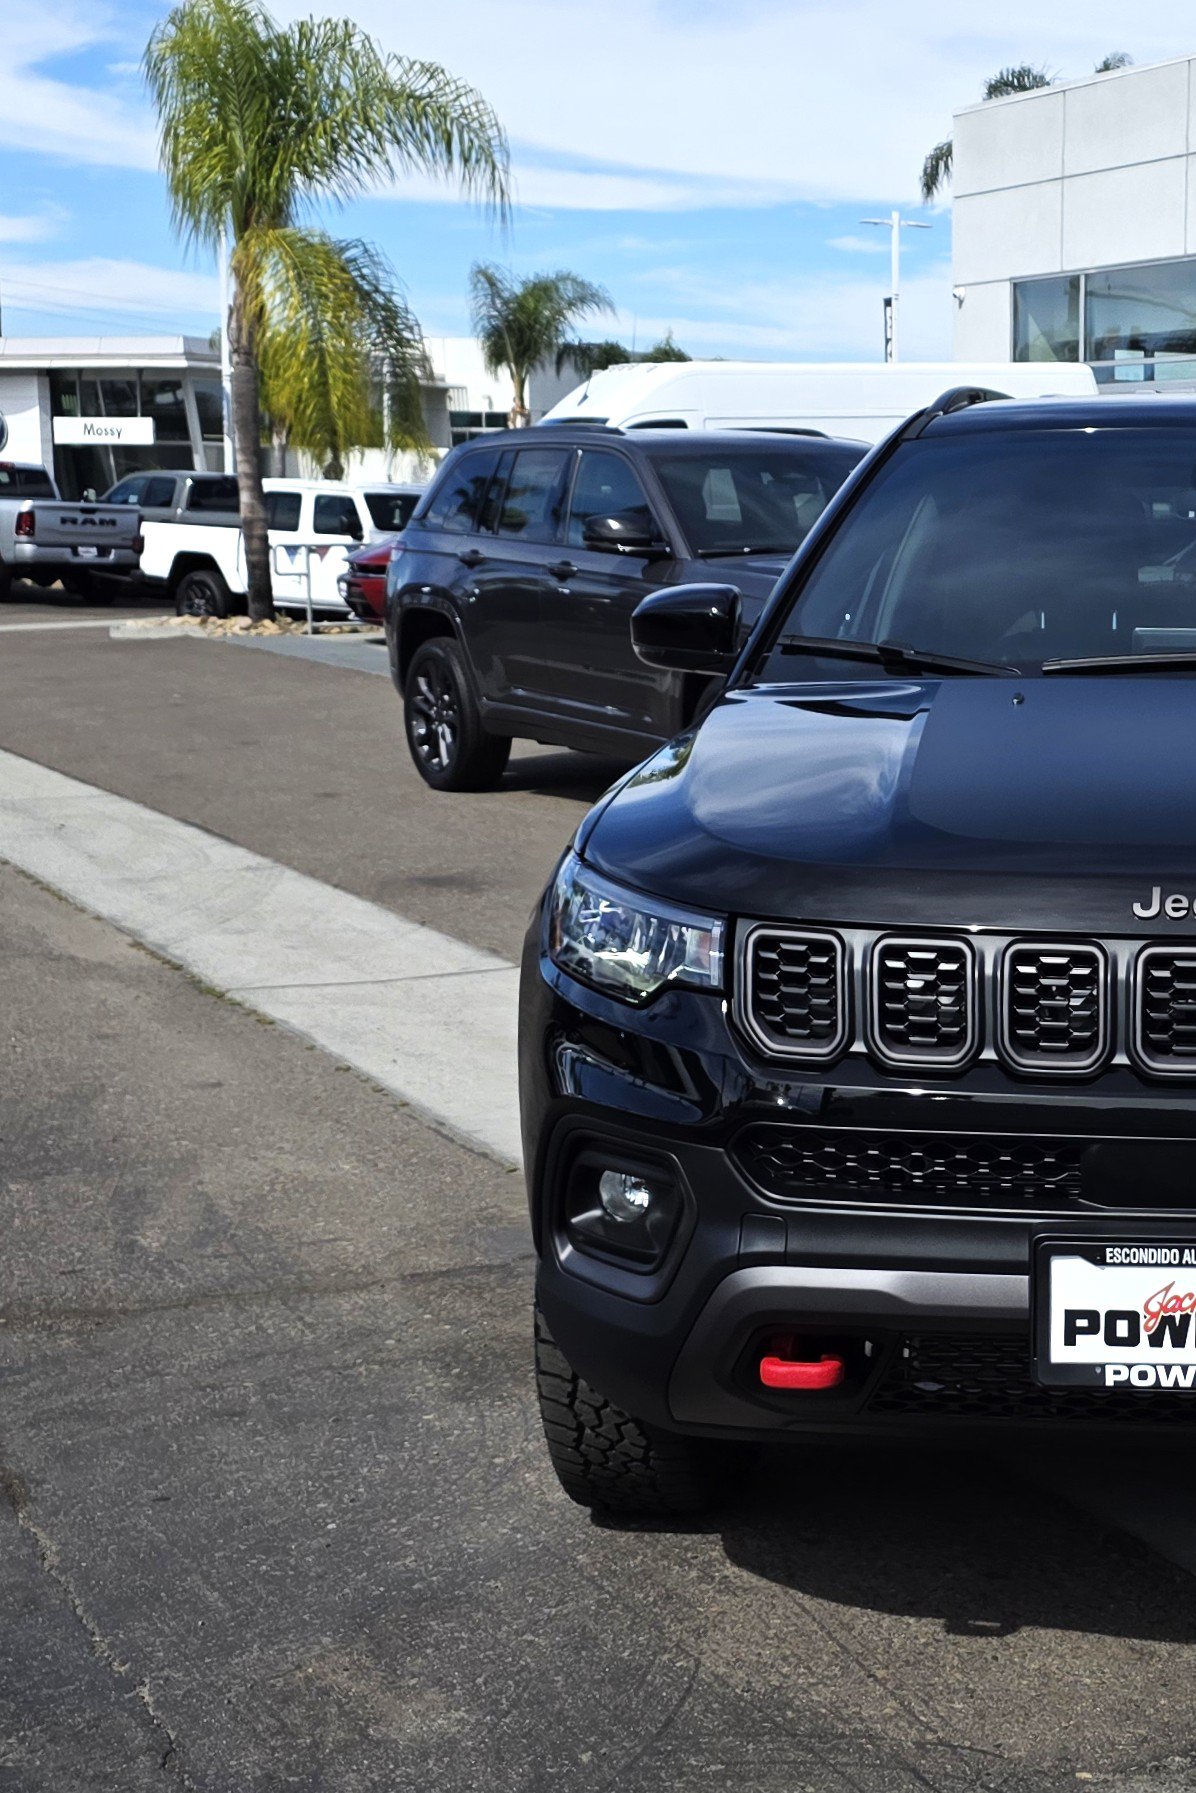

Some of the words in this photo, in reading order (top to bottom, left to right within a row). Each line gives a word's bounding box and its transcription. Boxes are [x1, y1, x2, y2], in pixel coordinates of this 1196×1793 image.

[83, 423, 123, 439] Mossy
[60, 516, 117, 527] RAM
[1105, 1247, 1180, 1264] ESCONDIDO
